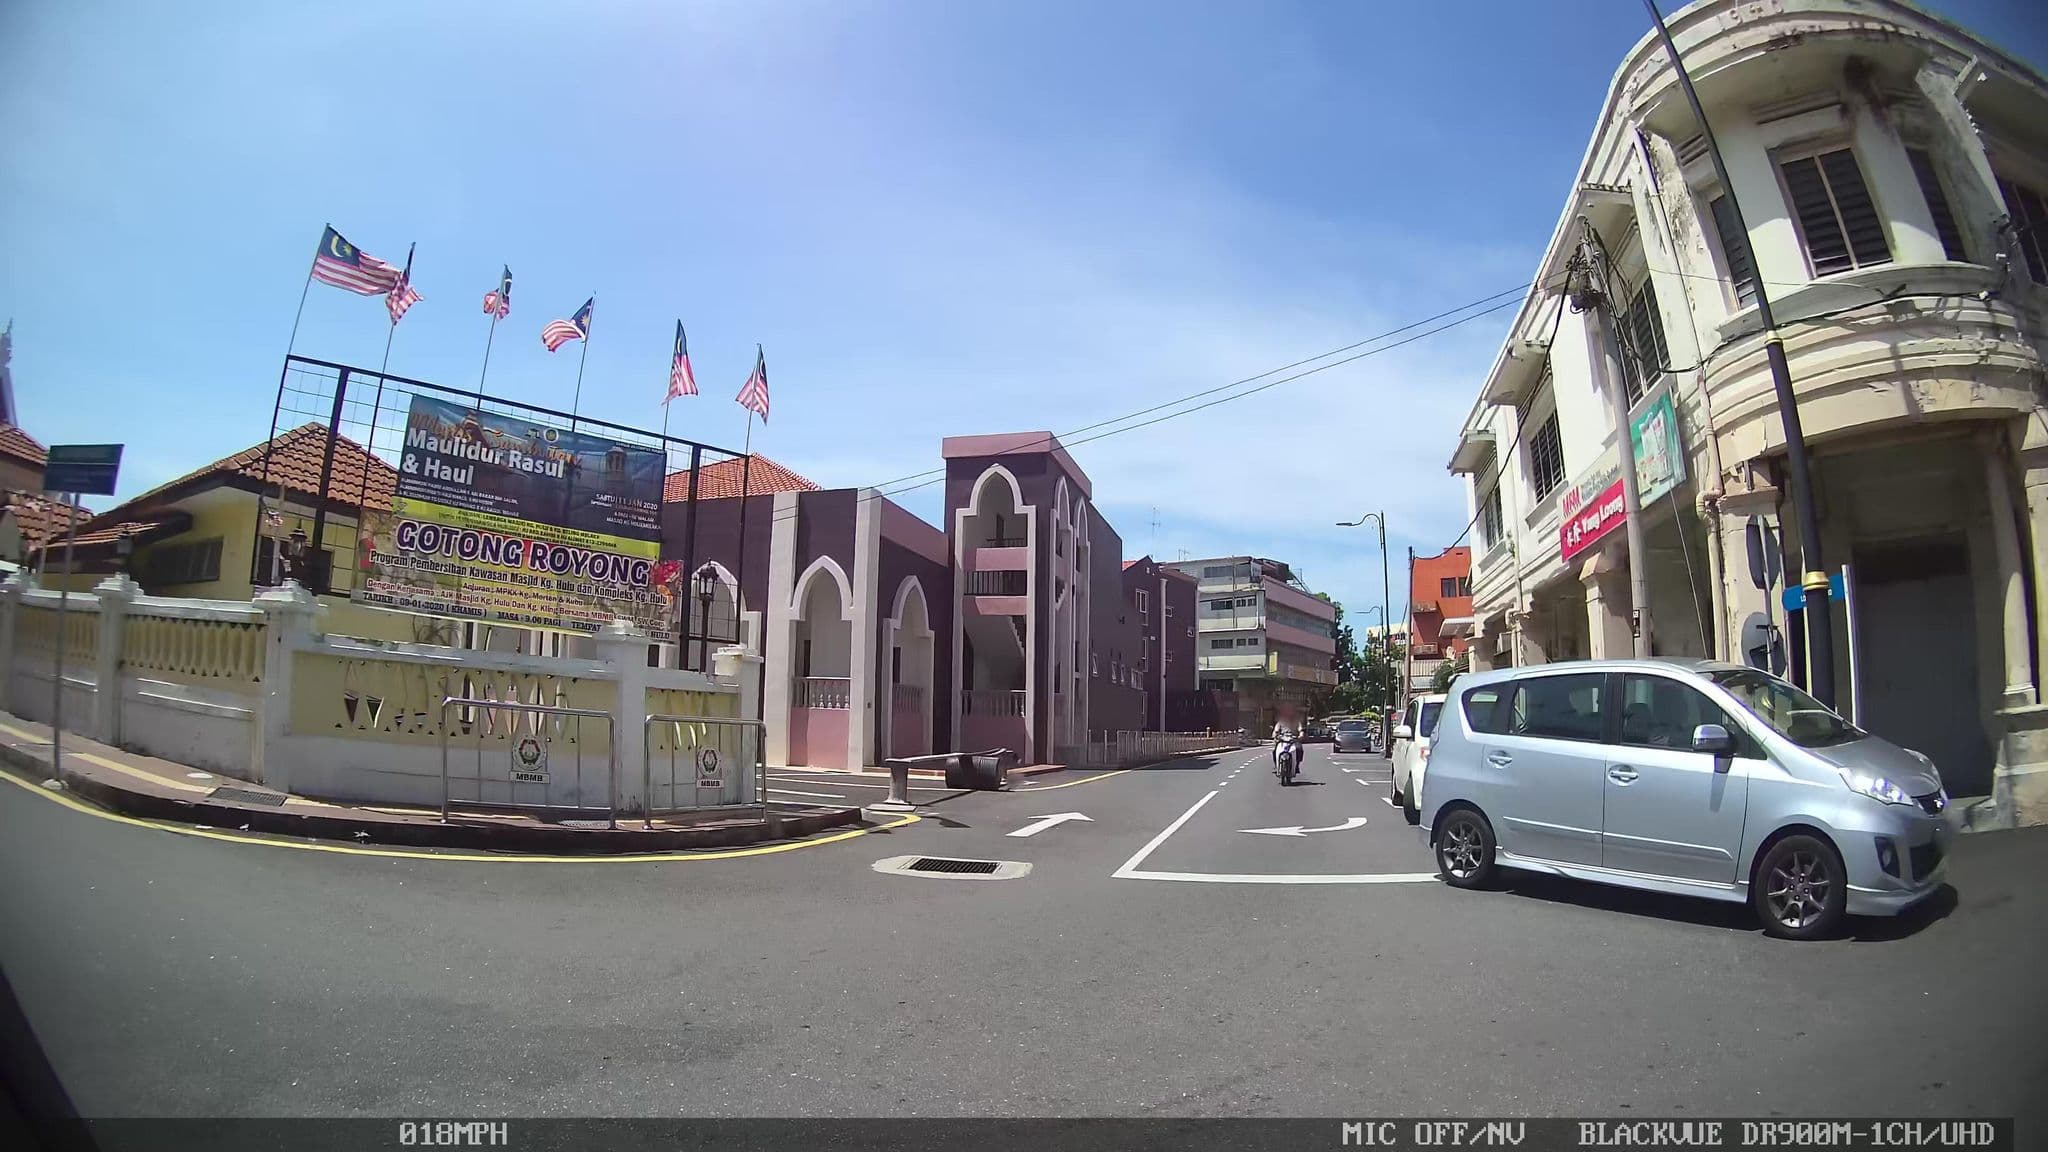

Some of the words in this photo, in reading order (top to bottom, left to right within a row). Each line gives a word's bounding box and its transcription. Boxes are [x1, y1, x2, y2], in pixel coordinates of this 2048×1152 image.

[402, 453, 419, 474] &
[423, 456, 475, 485] Haul
[406, 427, 504, 465] Maulidur
[508, 450, 566, 479] Rasul
[643, 502, 658, 510] 2020
[397, 520, 524, 567] GOTONG
[529, 542, 649, 586] ROYONG
[368, 579, 395, 590] Dengan
[456, 592, 479, 604] Masjid
[494, 598, 510, 607] Hulu
[512, 600, 525, 609] Dan
[370, 550, 408, 568] Program
[410, 557, 467, 577] Pembersihan
[469, 566, 508, 581] Kawasan
[510, 571, 538, 587] Masjid
[540, 576, 554, 590] Kg.
[556, 579, 575, 592] Hulu
[577, 582, 592, 594] dan
[594, 585, 633, 601] Kompleks
[635, 590, 648, 603] Kg.
[650, 593, 668, 605] Hulu
[363, 592, 393, 603] TARIKH
[452, 604, 482, 616] KHAMIS
[498, 611, 519, 622] MASA
[544, 618, 561, 627] PAGI
[571, 621, 602, 632] TEMPAT
[516, 773, 543, 782] MBMB
